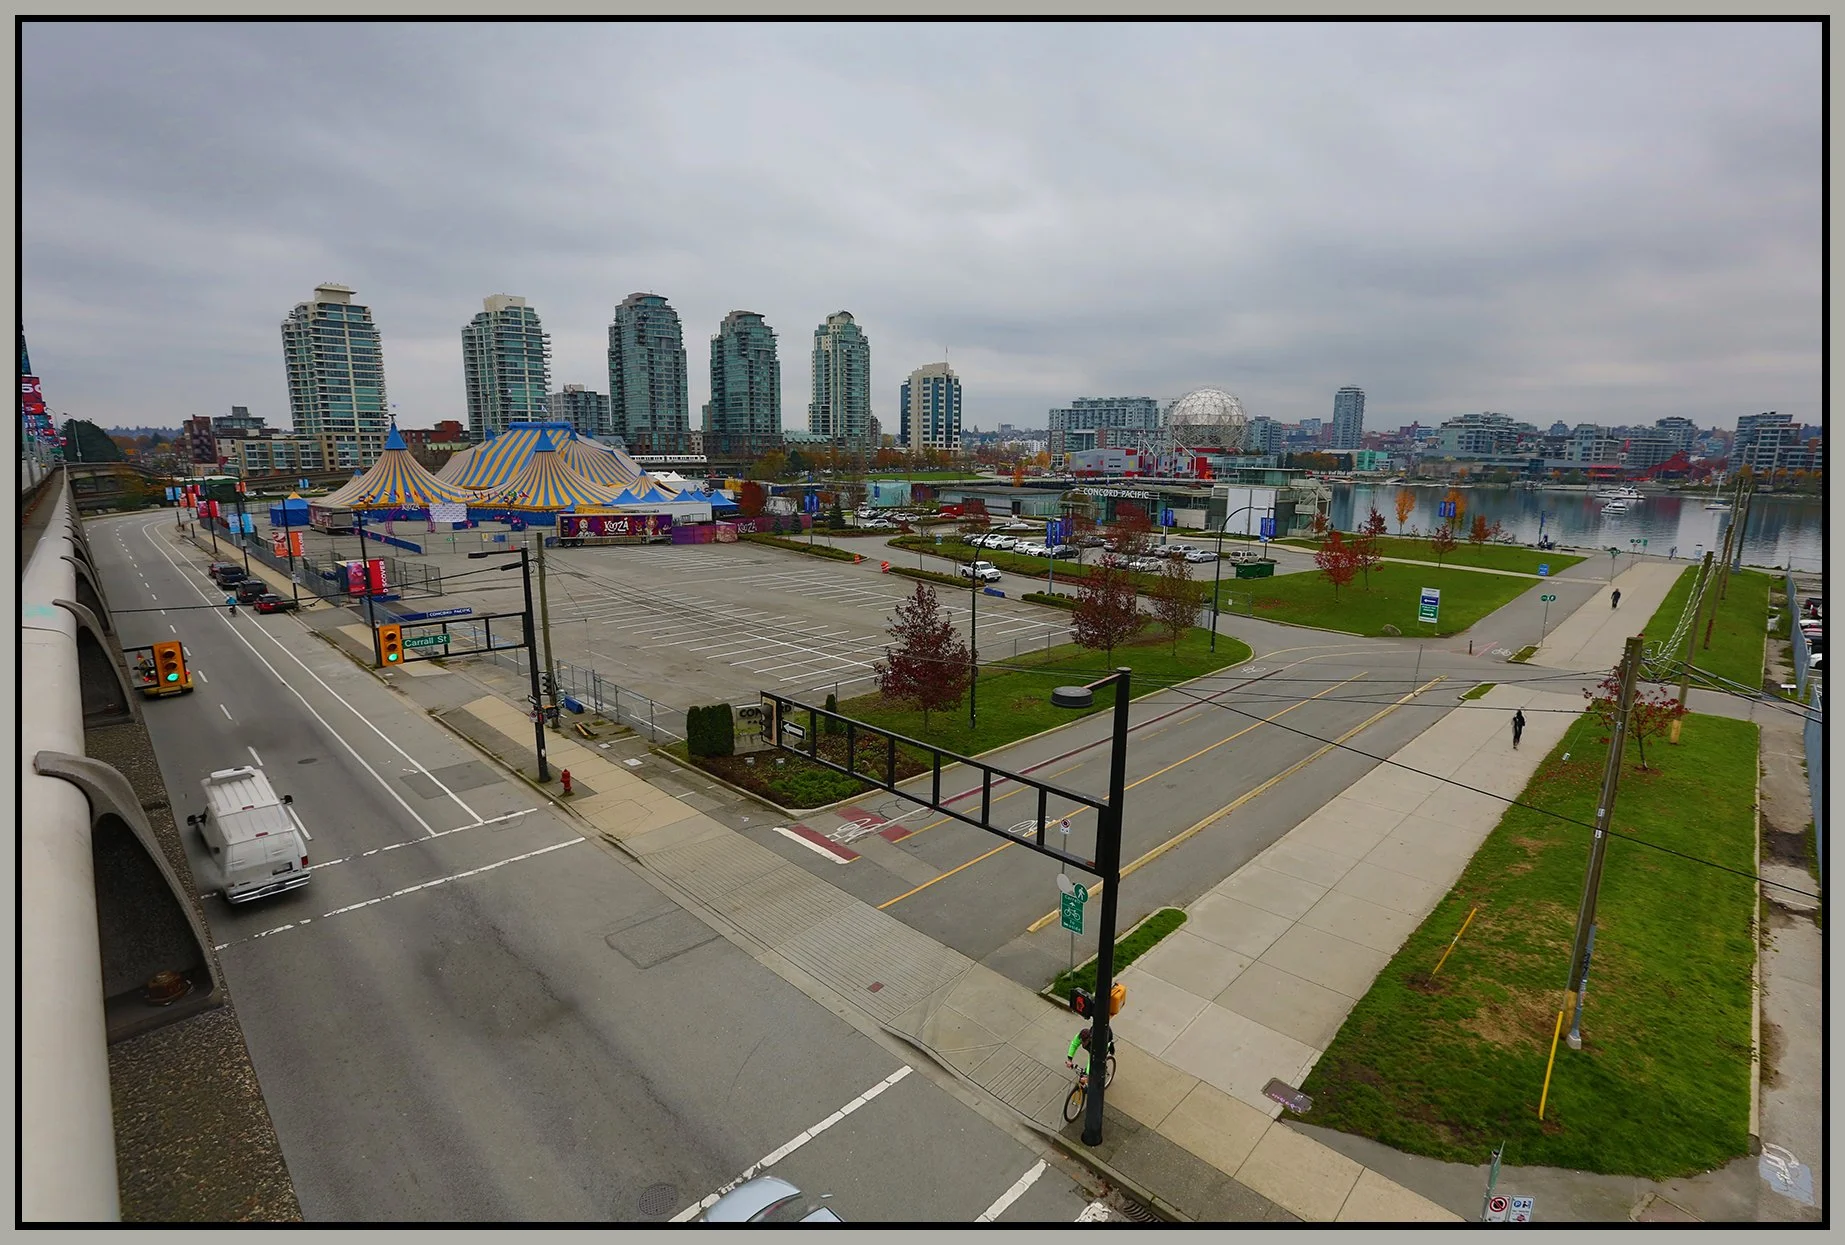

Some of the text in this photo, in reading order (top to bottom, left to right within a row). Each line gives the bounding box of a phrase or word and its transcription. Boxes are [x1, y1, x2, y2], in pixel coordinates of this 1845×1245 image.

[1083, 488, 1149, 499] CONCORD PACIFIC
[379, 560, 389, 593] DSCOVER
[404, 638, 434, 648] Carrall
